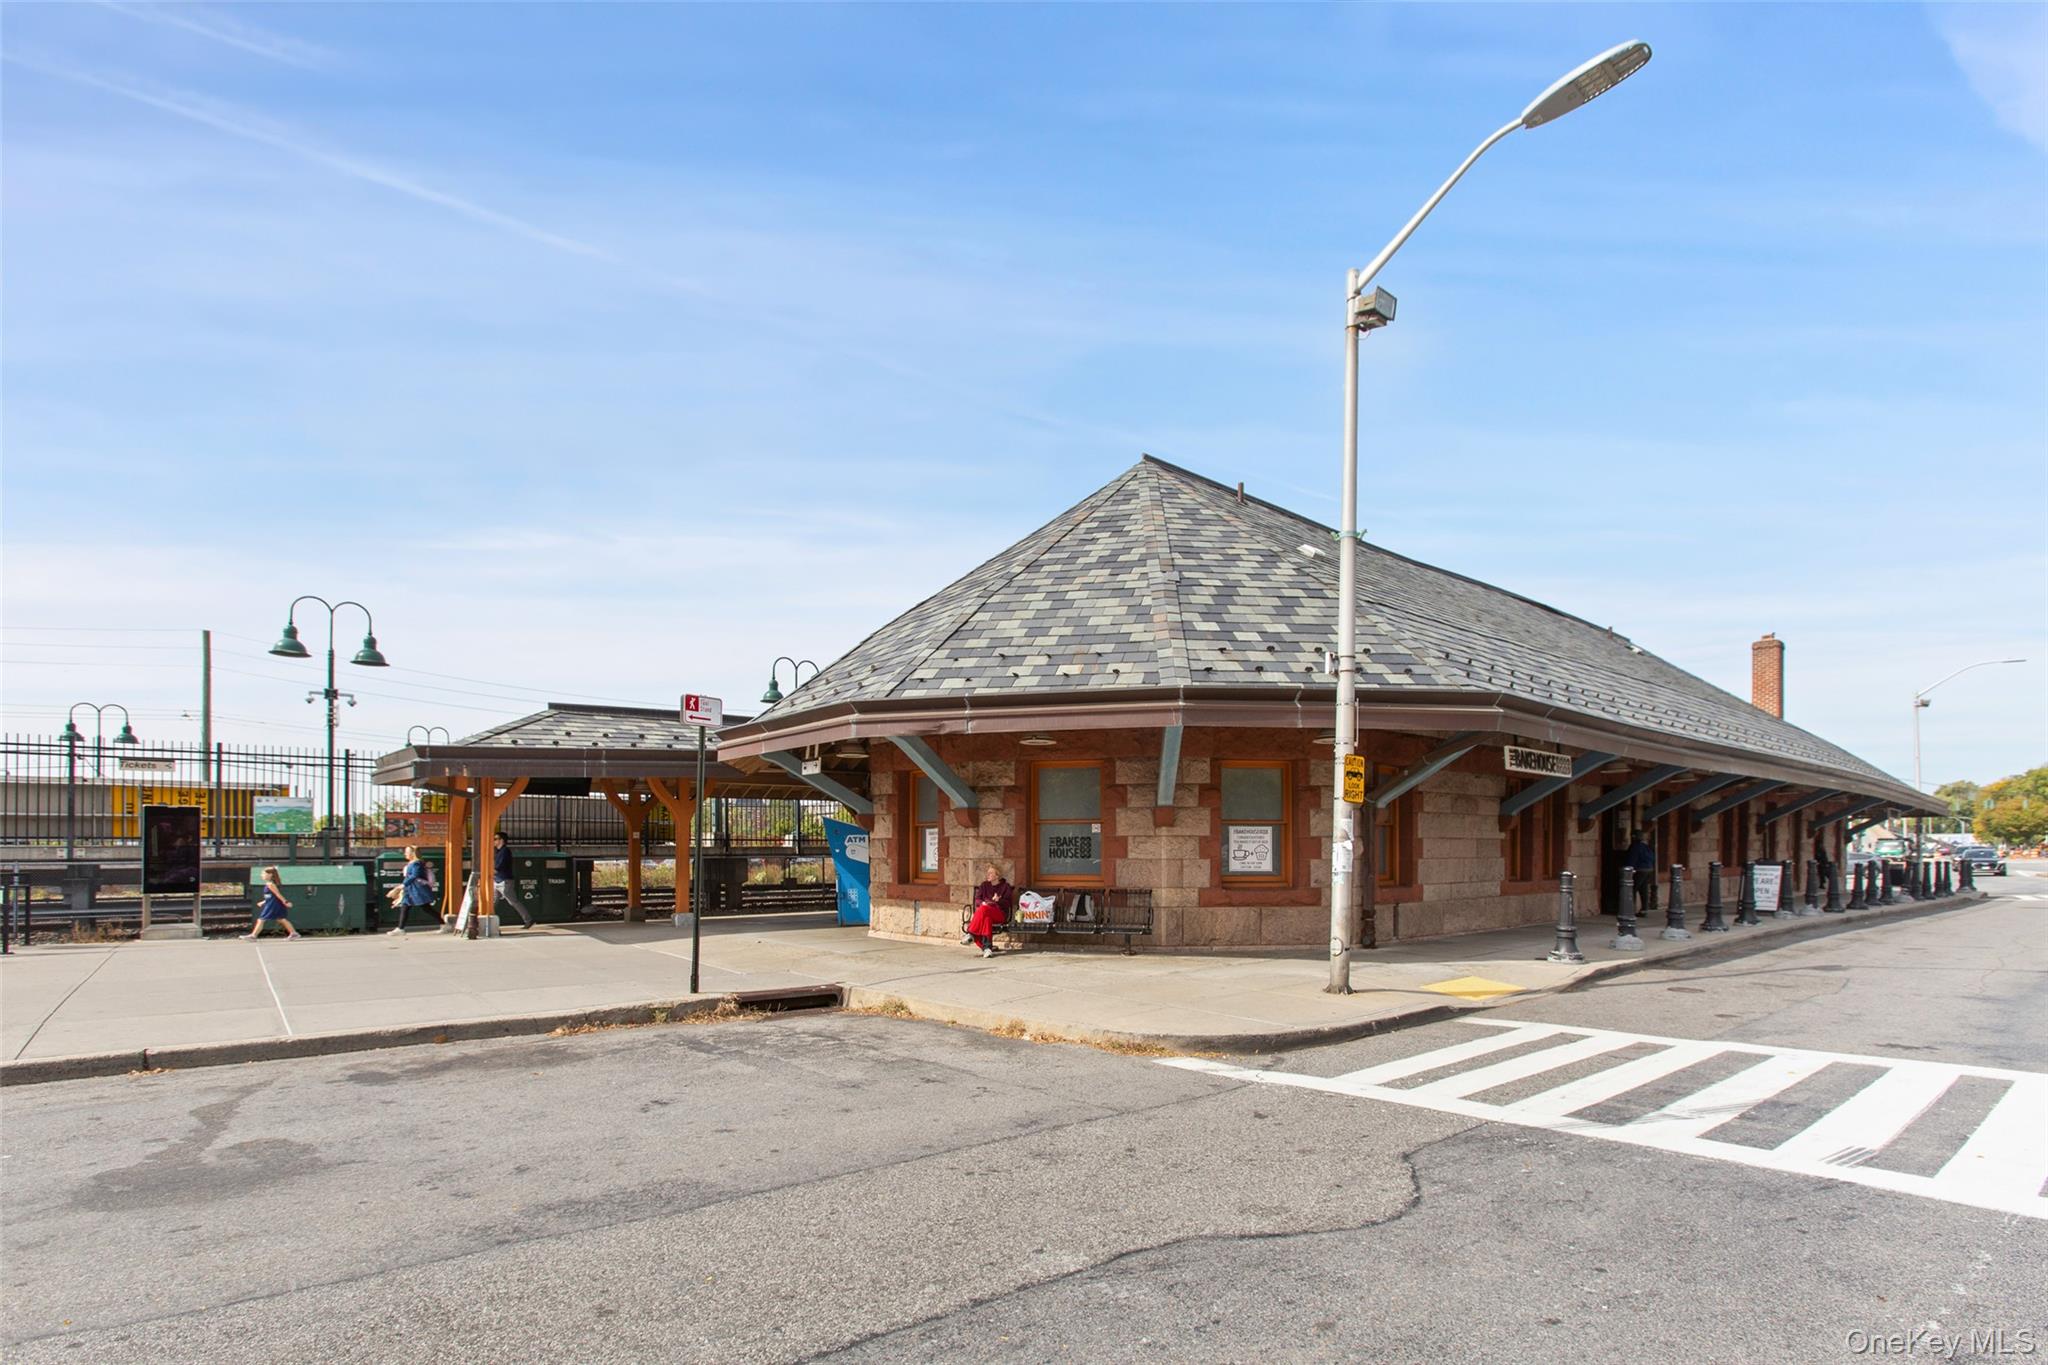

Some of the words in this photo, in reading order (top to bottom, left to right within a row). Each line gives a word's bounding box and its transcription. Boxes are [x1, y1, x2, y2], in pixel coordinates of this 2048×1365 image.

[121, 761, 157, 769] Tickets
[1345, 790, 1363, 800] RIGHT
[1056, 836, 1080, 847] BAKE
[1049, 847, 1080, 859] HOUSE
[1754, 887, 1770, 895] PEN
